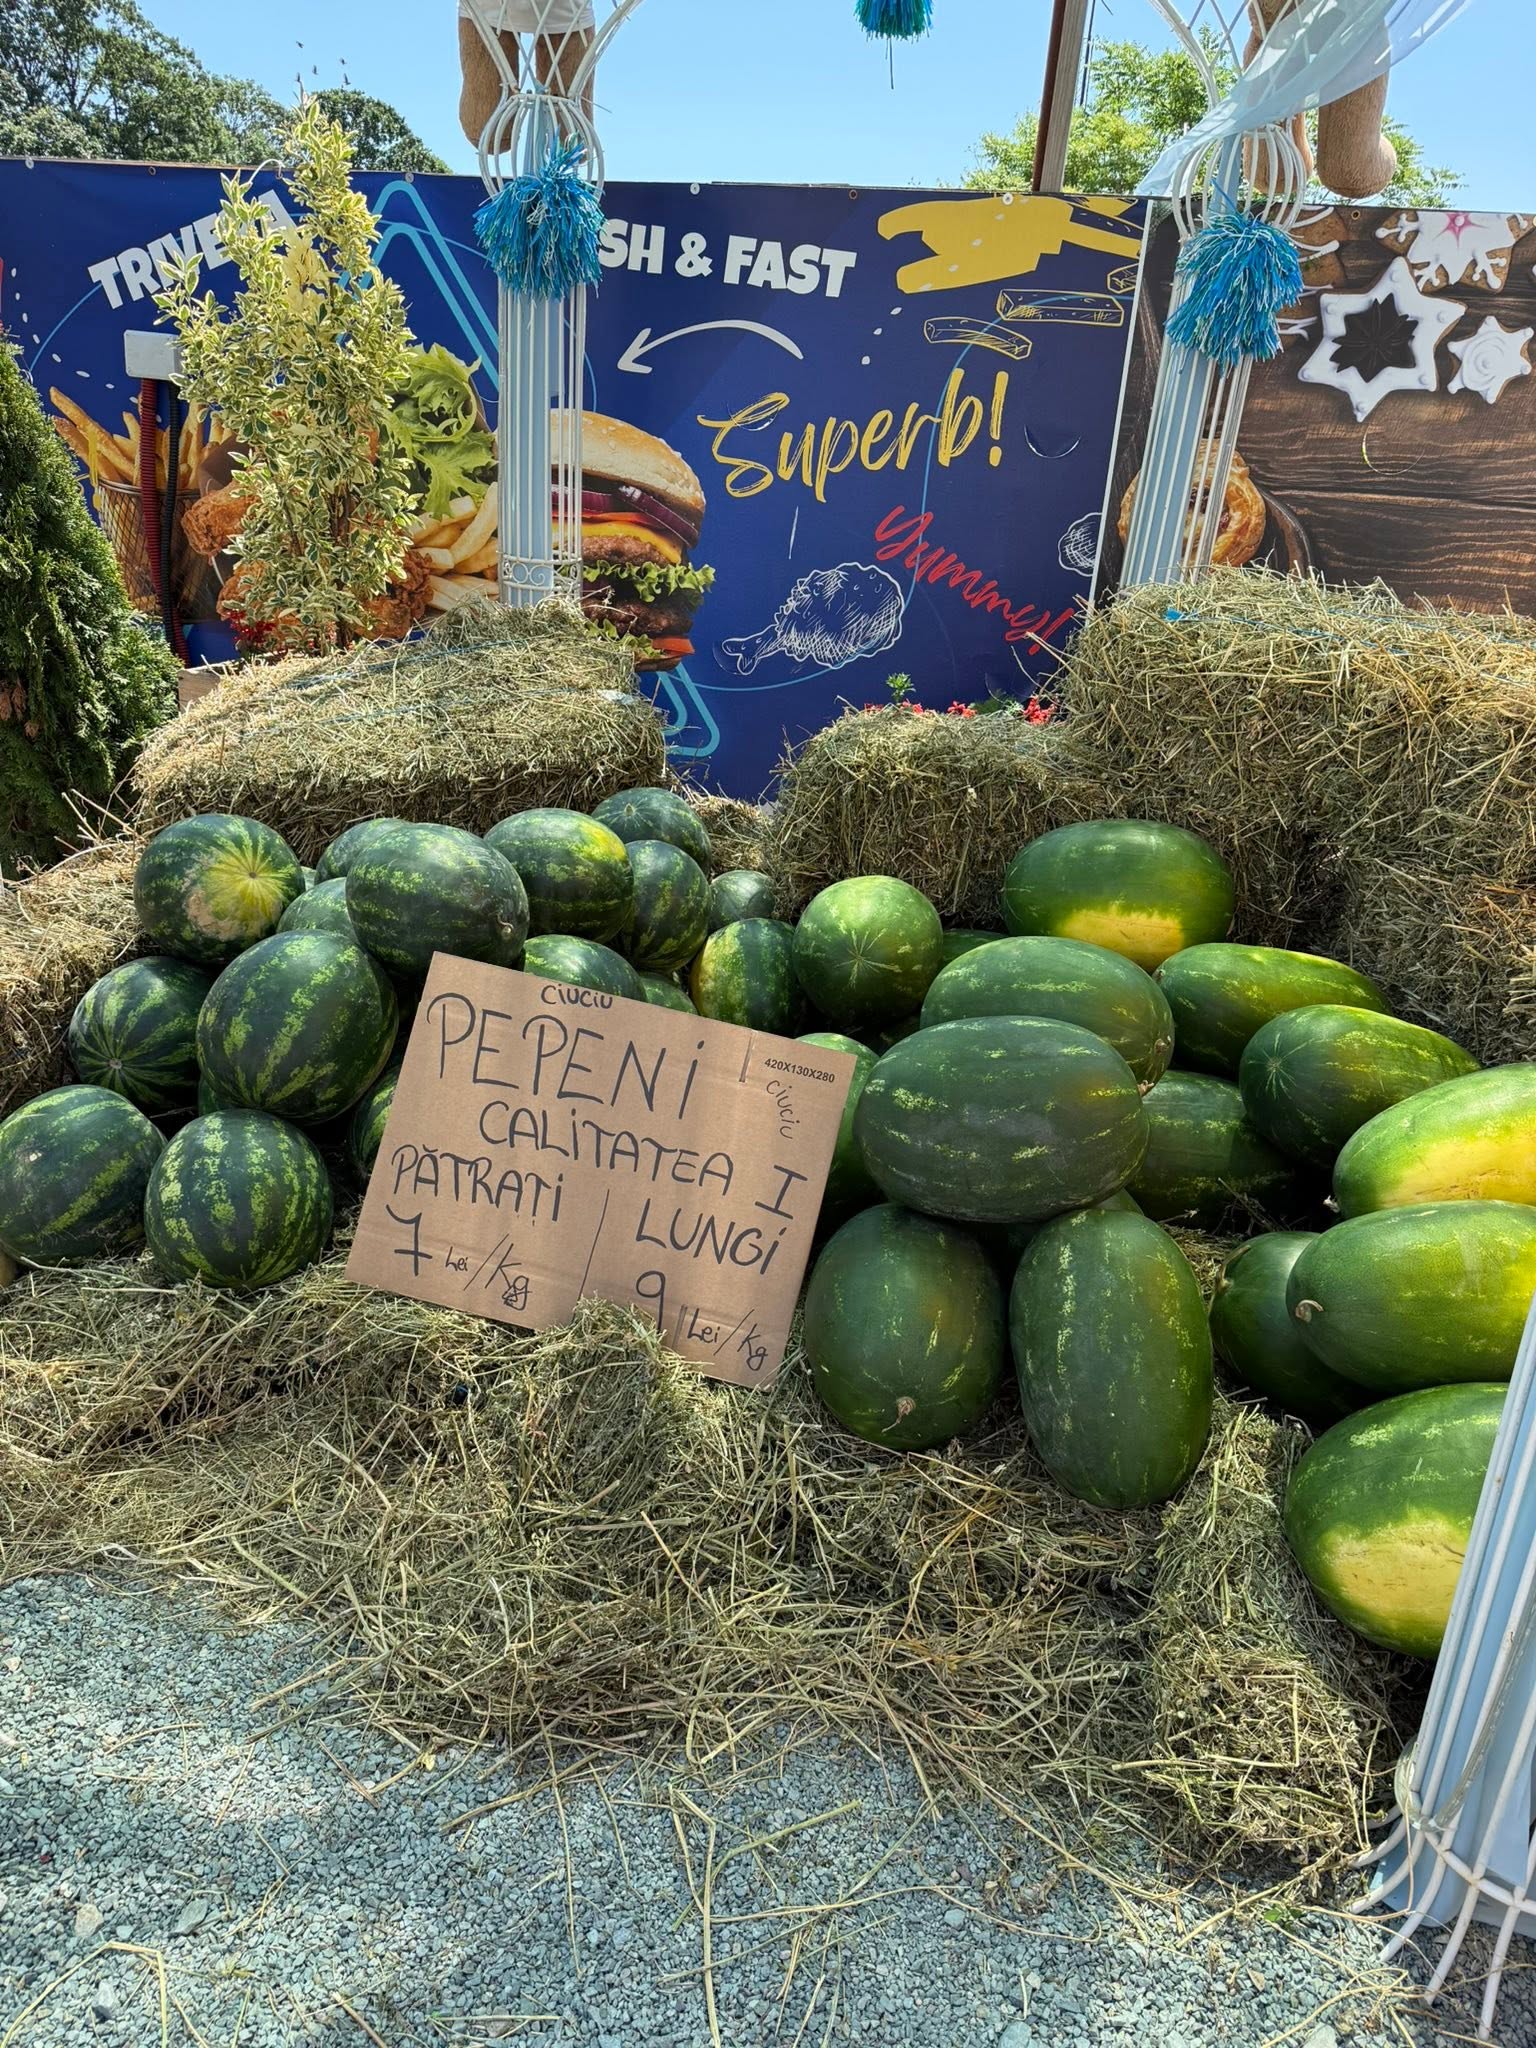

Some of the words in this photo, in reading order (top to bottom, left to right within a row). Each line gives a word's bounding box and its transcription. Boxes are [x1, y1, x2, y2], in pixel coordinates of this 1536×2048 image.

[87, 189, 302, 310] TRIVEA
[675, 232, 713, 277] &
[723, 234, 857, 298] FAST
[696, 367, 1008, 502] Superb!
[875, 505, 1075, 655] Yummy!
[764, 1058, 836, 1083] 420X130X280
[755, 1164, 808, 1220] I
[386, 1204, 433, 1277] 7
[635, 1270, 666, 1332] 9
